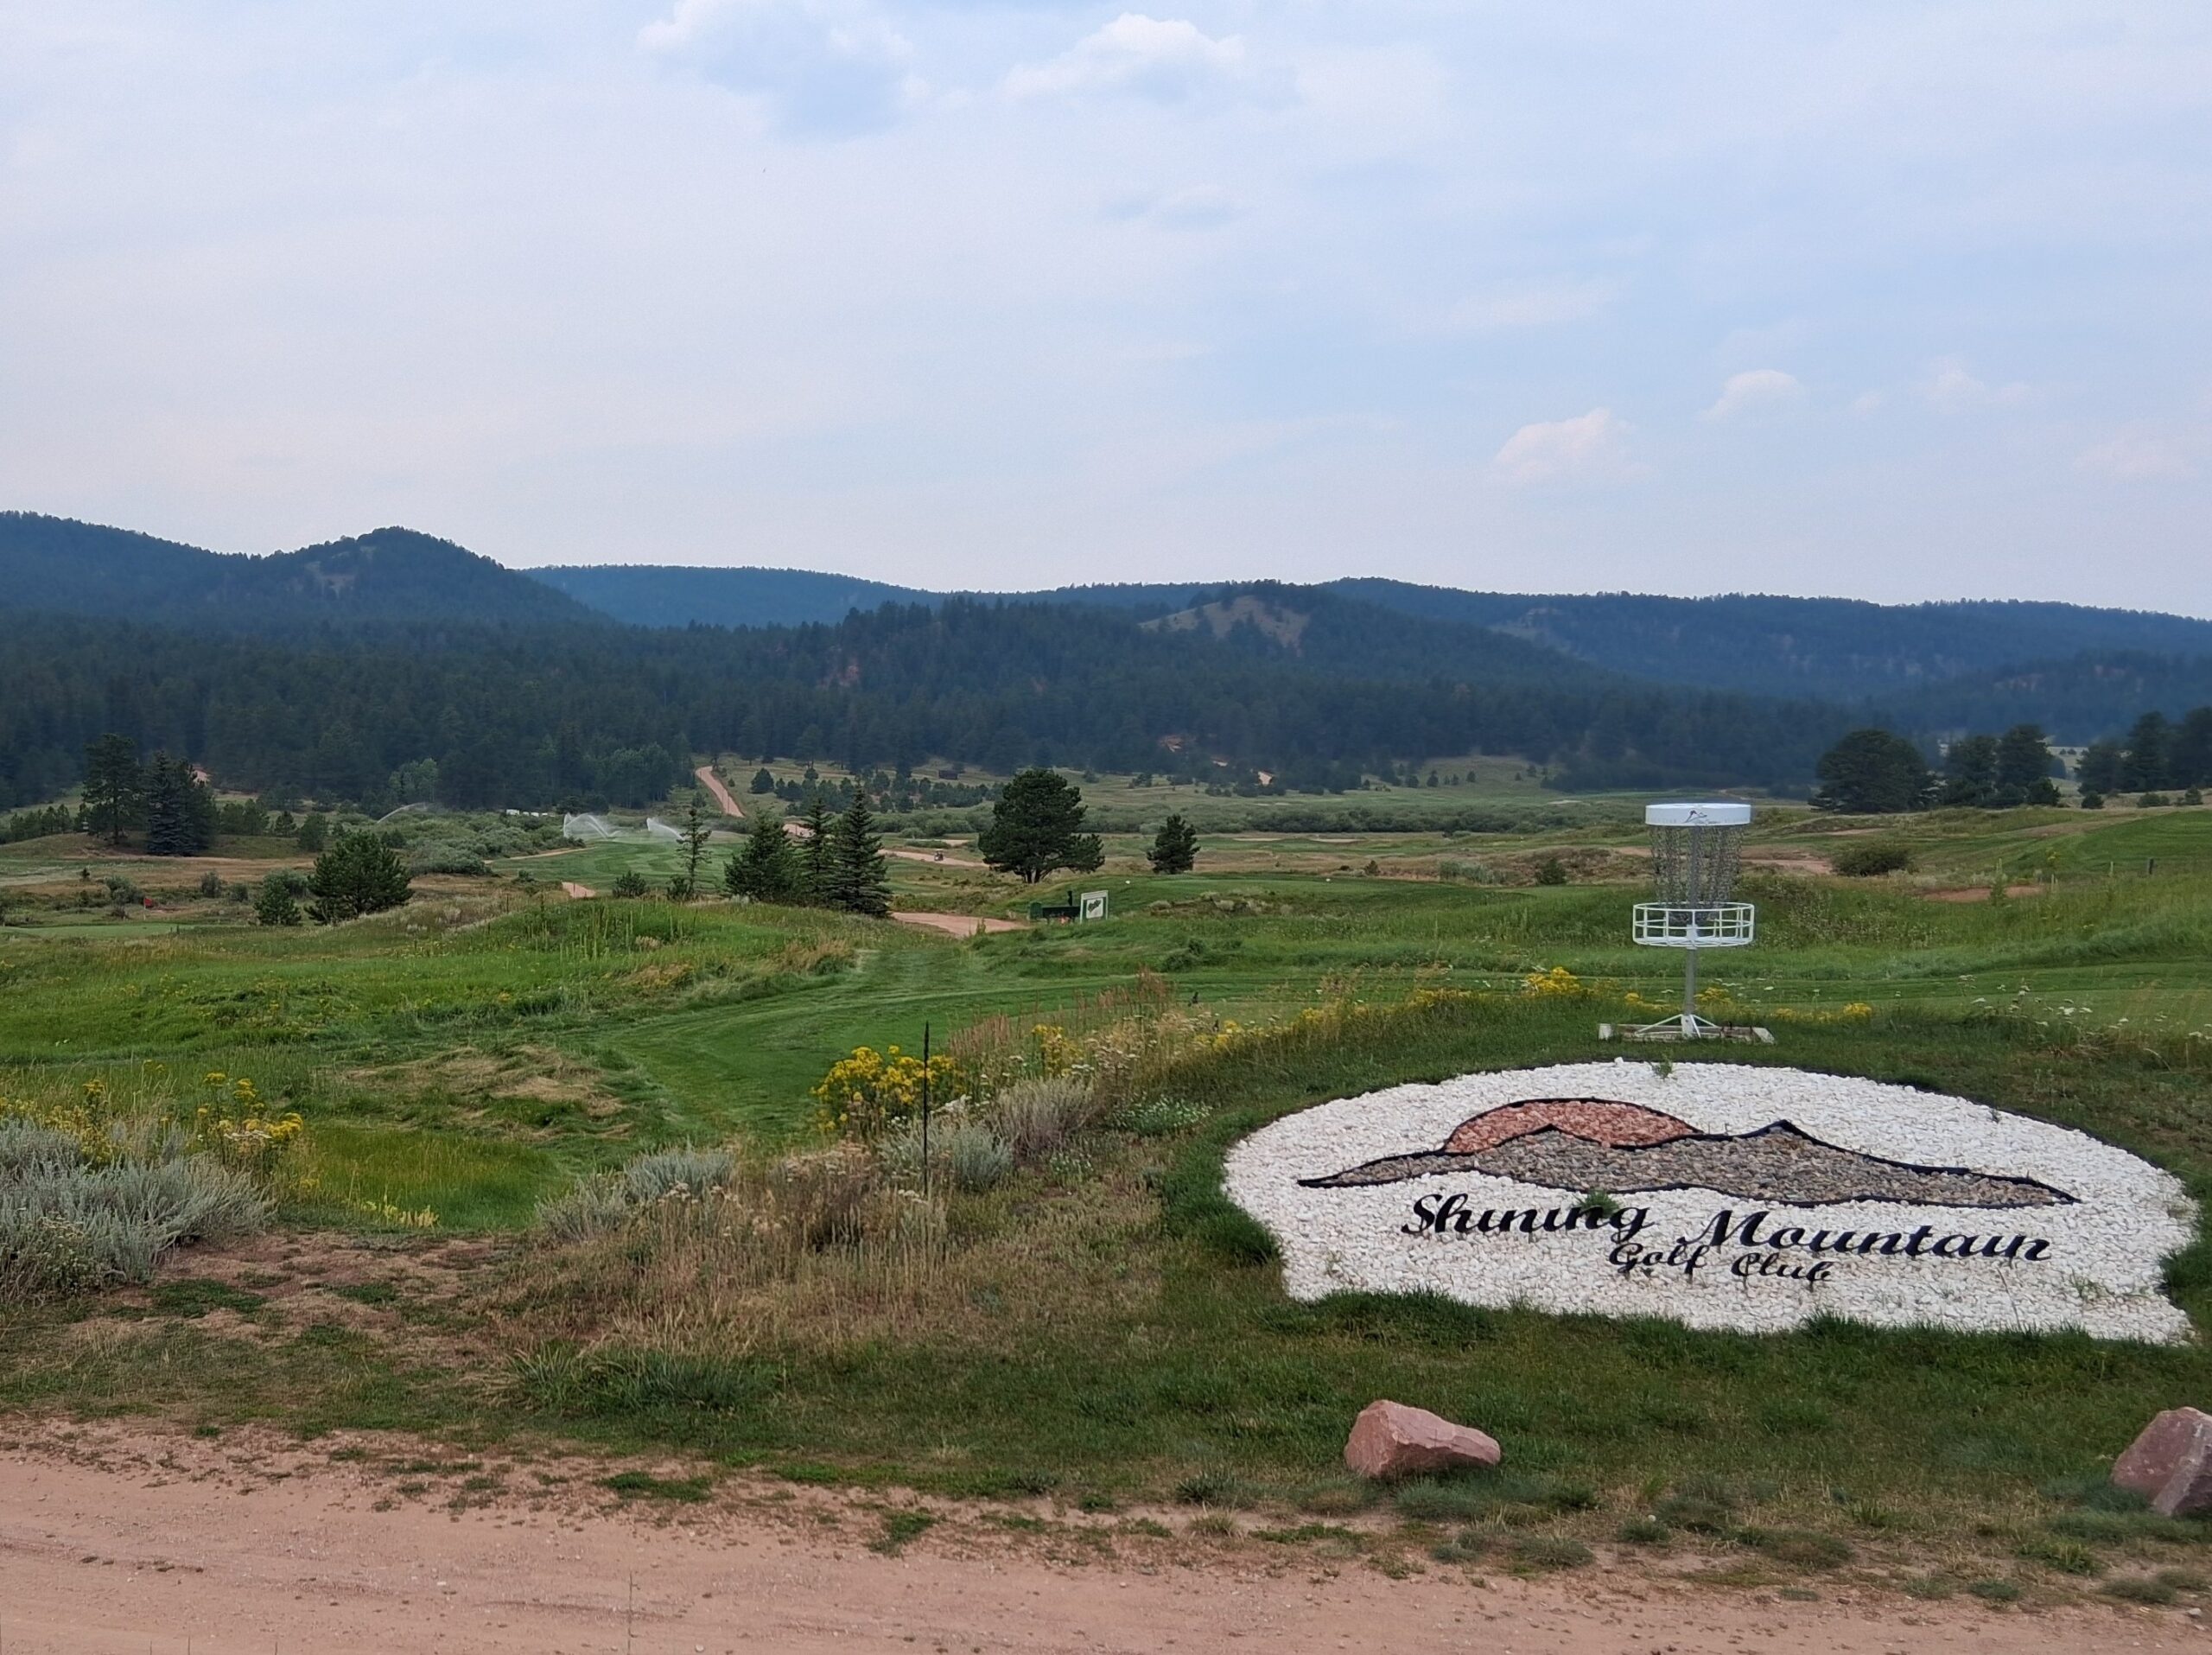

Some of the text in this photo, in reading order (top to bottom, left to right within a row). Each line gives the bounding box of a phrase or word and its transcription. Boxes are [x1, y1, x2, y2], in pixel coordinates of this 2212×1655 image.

[1401, 1193, 2051, 1261] Shining Mountain
[1609, 1243, 1834, 1281] Golf Club
